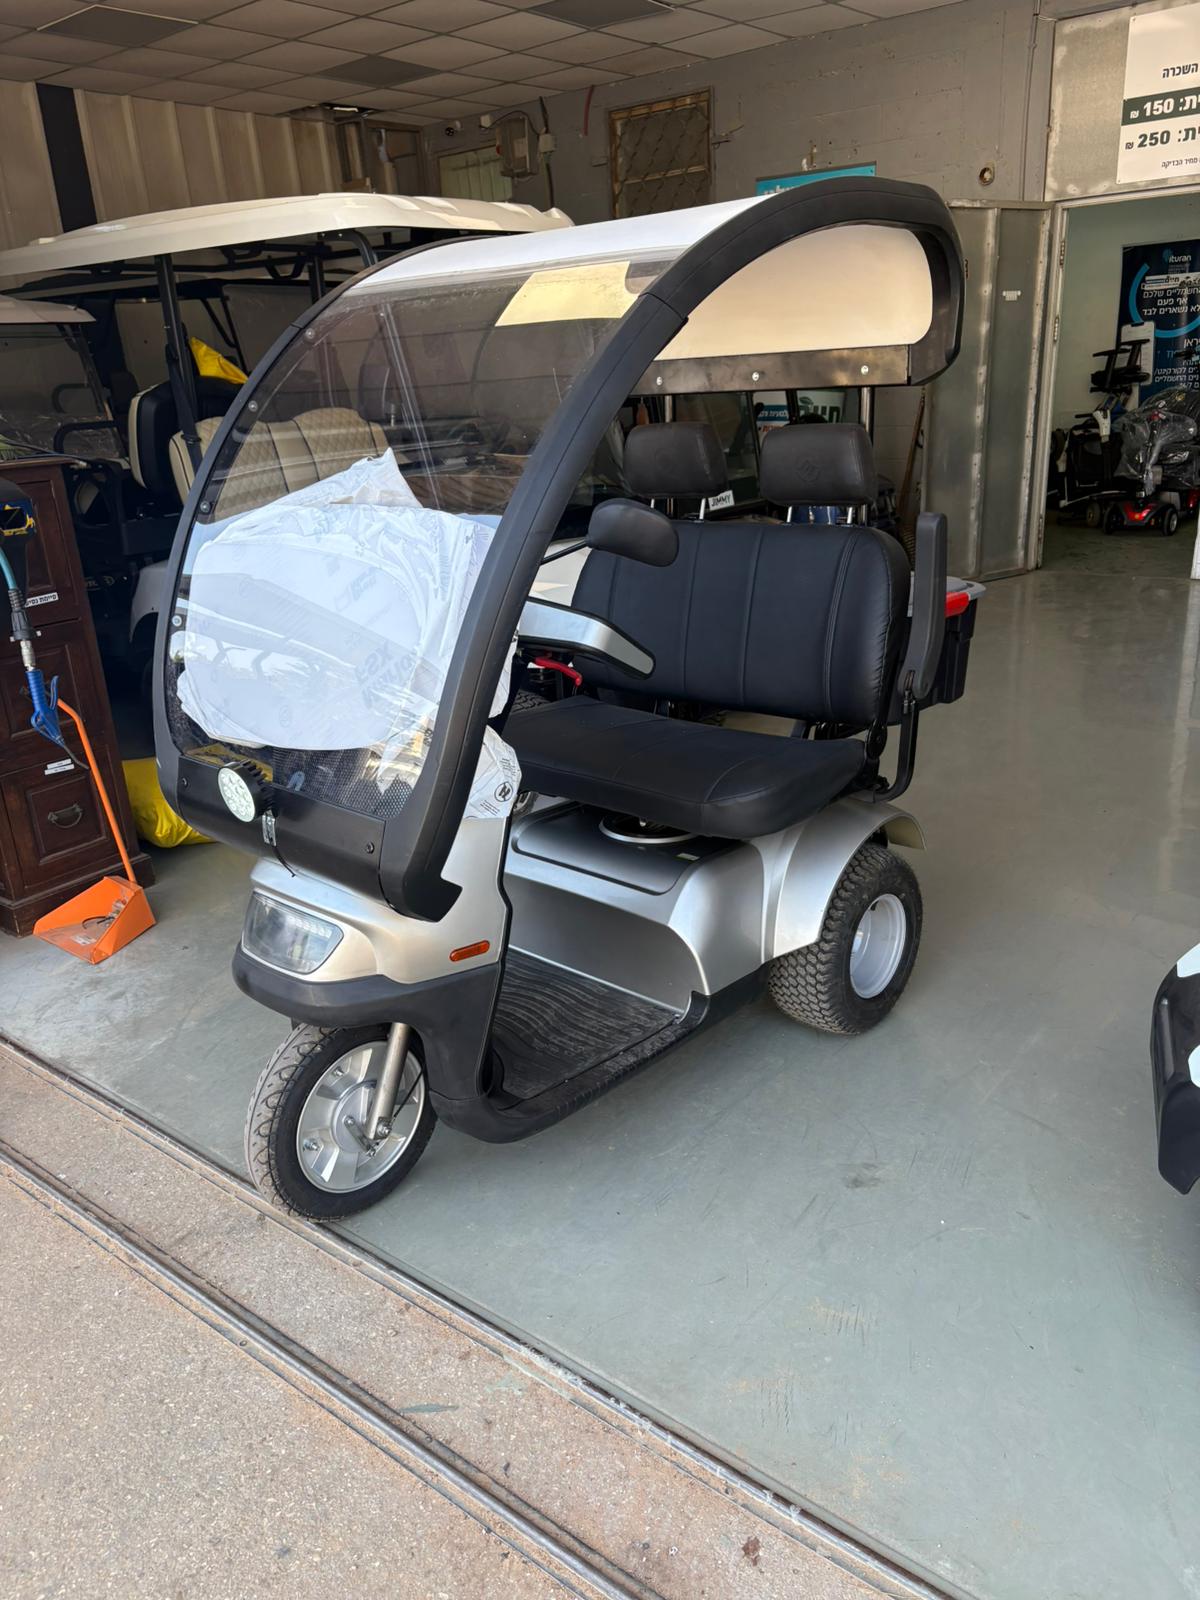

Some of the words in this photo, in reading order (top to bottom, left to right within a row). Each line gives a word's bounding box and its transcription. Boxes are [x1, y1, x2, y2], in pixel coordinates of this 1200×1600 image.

[1162, 63, 1199, 78] השכרה
[1143, 98, 1174, 116] 150
[1137, 130, 1171, 148] 250
[1168, 255, 1192, 263] ituran
[711, 493, 731, 507] JIMMY
